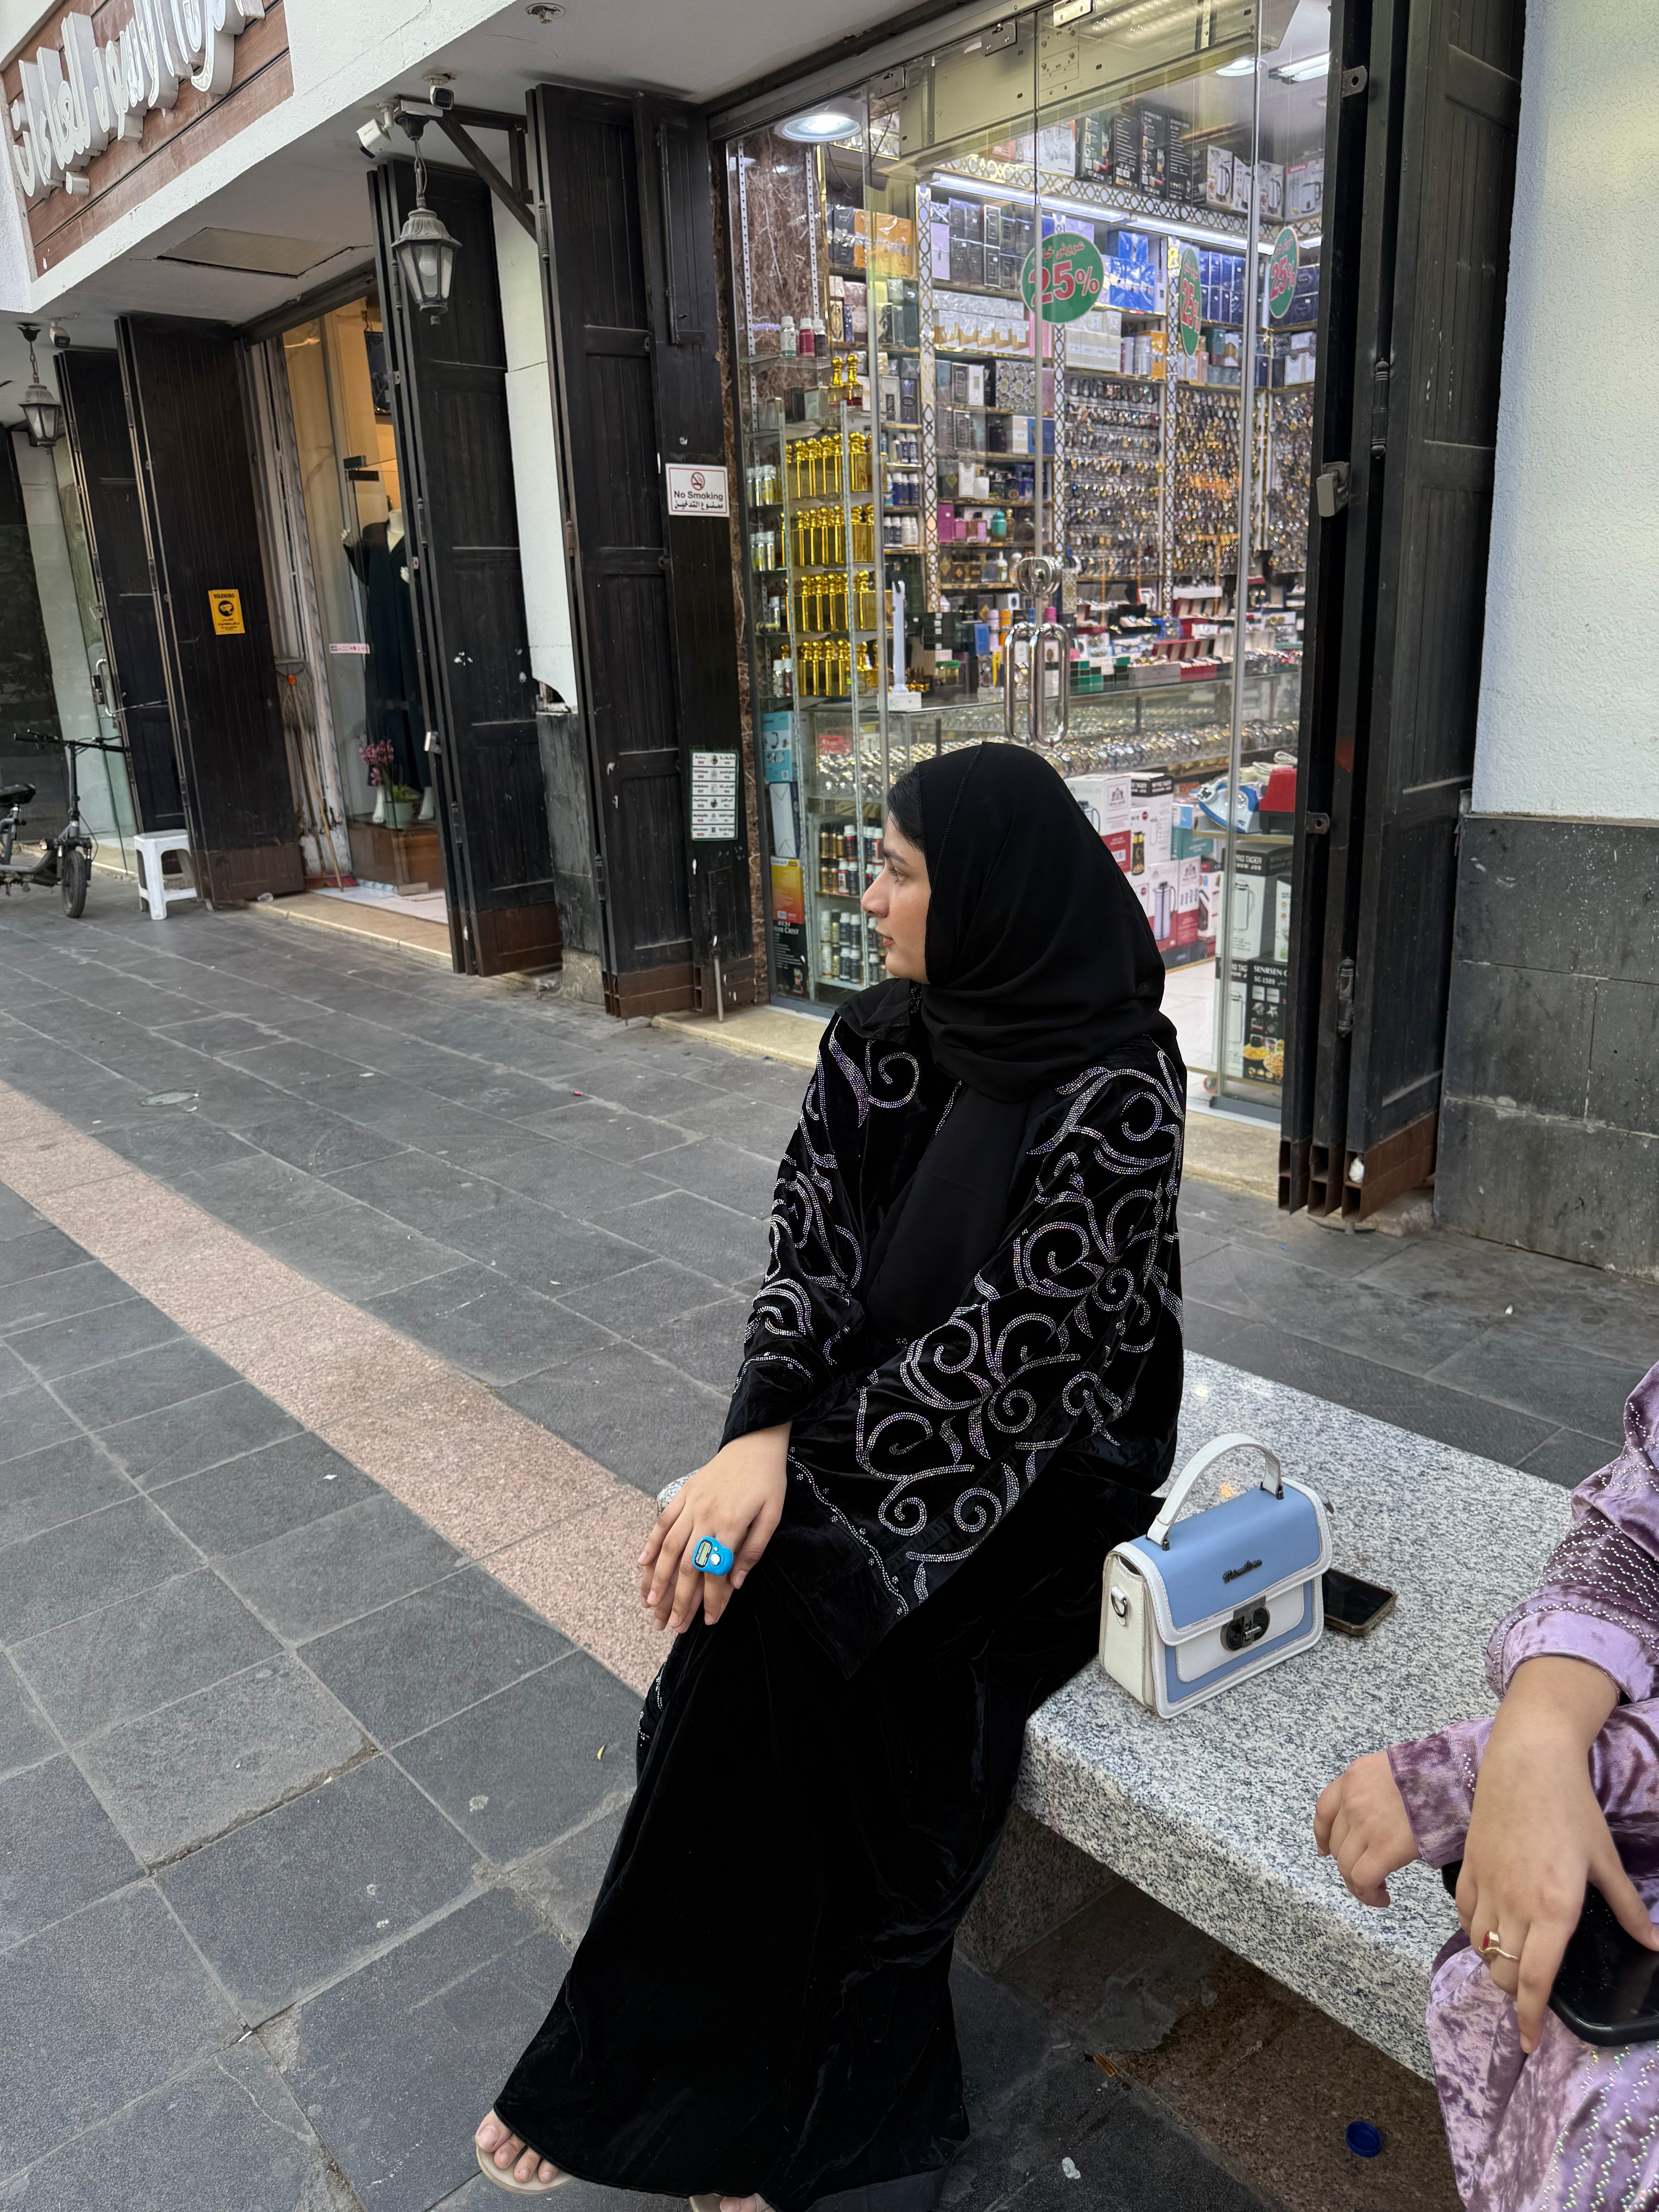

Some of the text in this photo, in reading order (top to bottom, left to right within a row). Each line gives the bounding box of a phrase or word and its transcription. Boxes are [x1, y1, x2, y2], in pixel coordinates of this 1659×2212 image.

[1028, 260, 1099, 307] 25%
[1270, 254, 1296, 301] 25%
[674, 490, 723, 502] No Smoking
